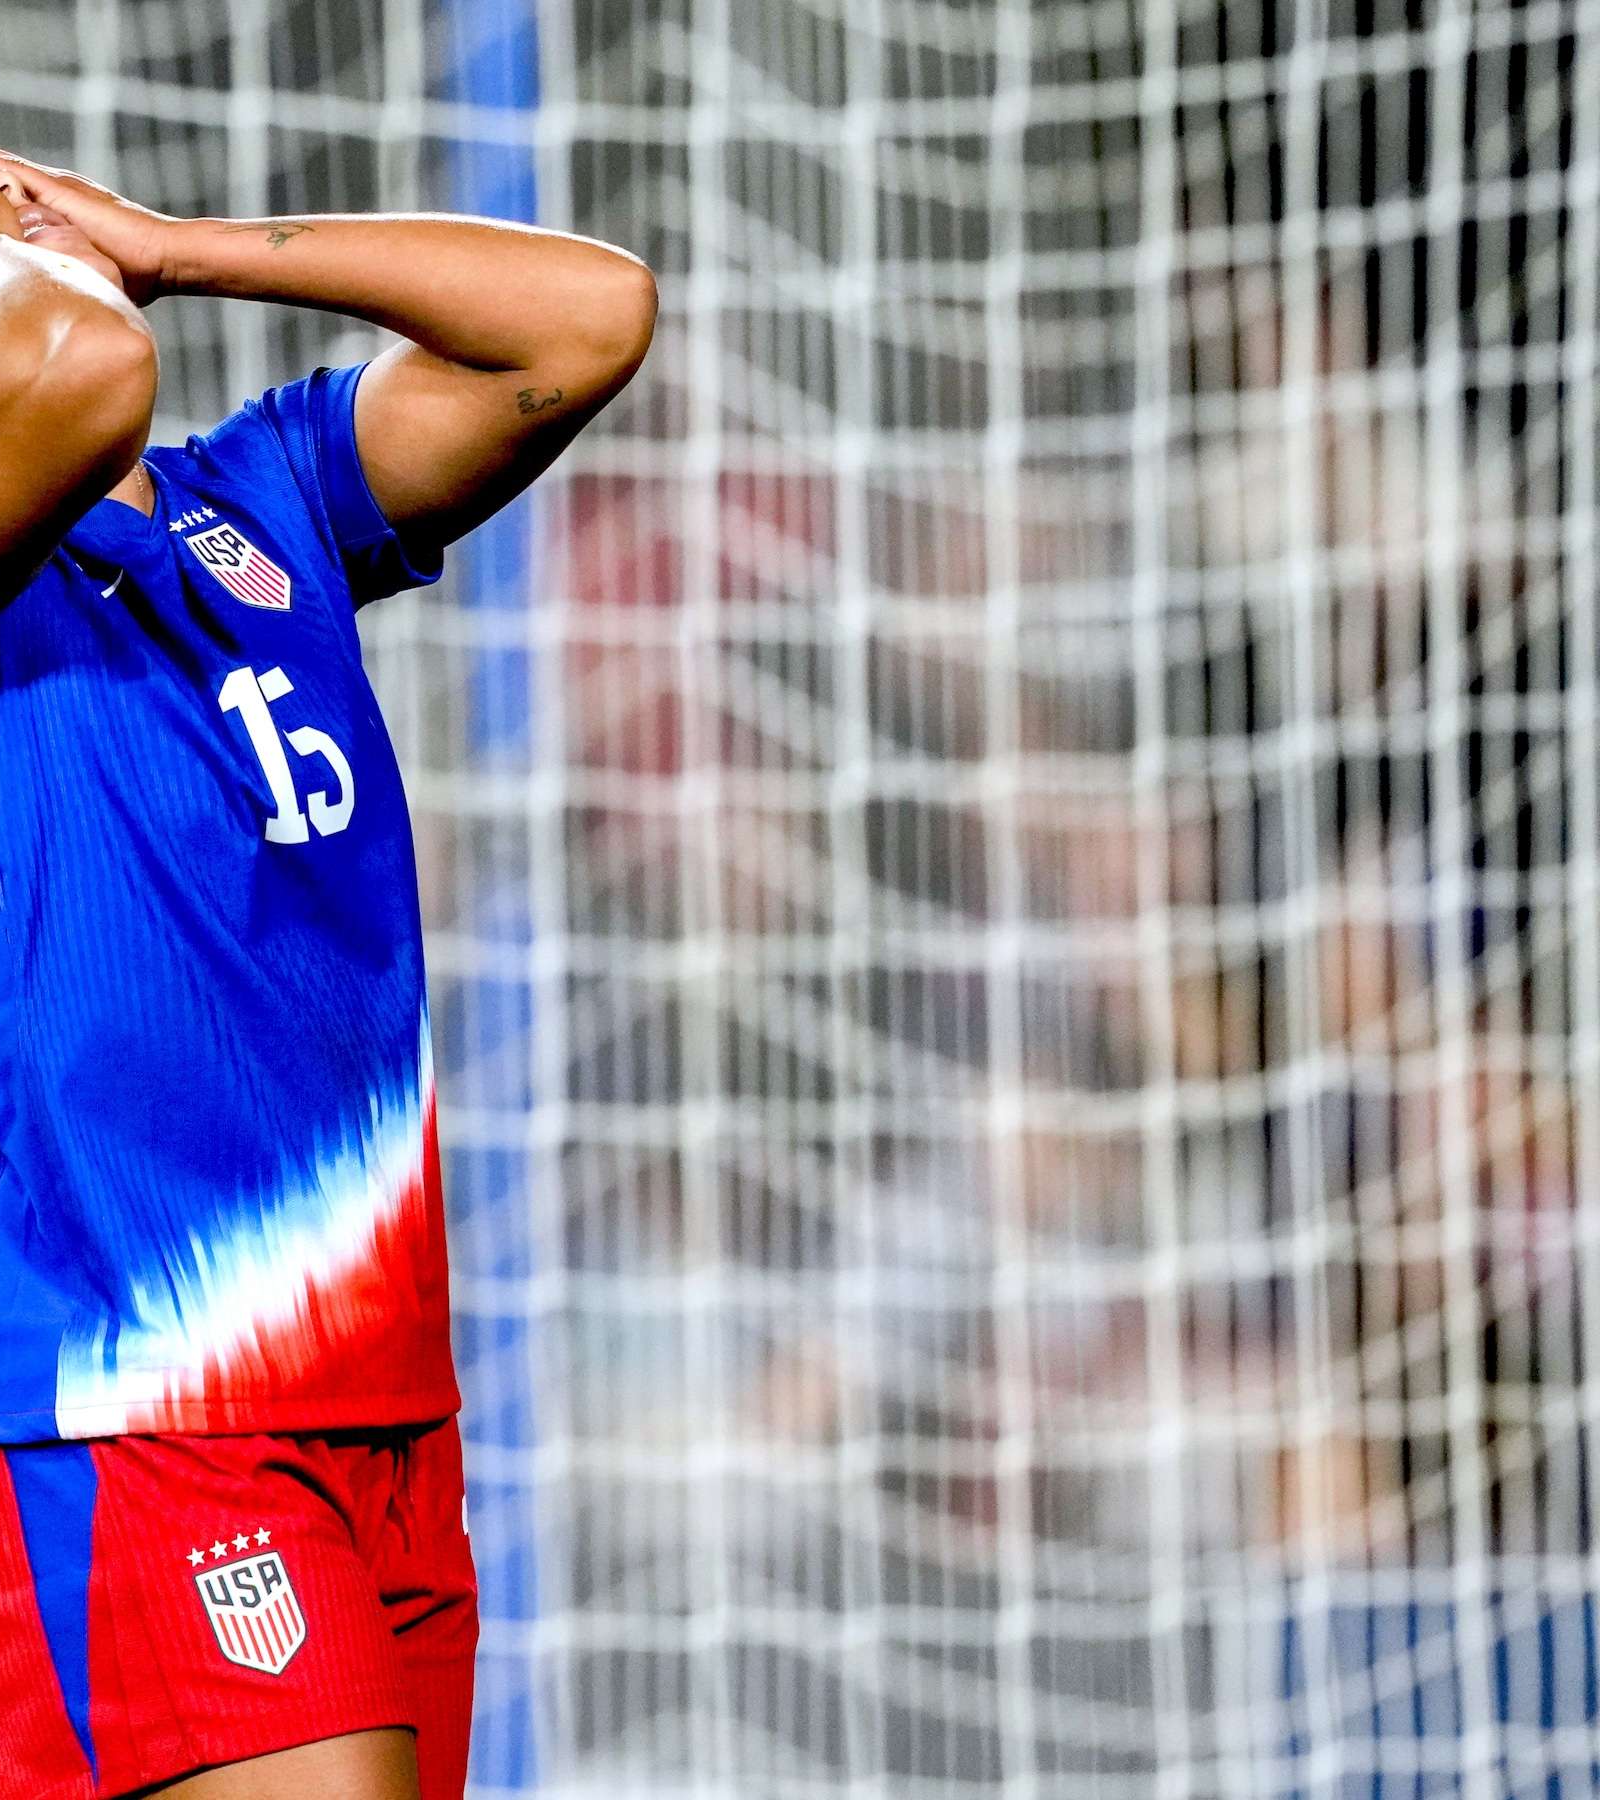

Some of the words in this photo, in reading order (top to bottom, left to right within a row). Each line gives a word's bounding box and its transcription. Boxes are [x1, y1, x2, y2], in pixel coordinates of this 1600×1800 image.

[193, 529, 246, 567] USA
[218, 665, 355, 844] 15
[204, 1559, 282, 1609] USA
